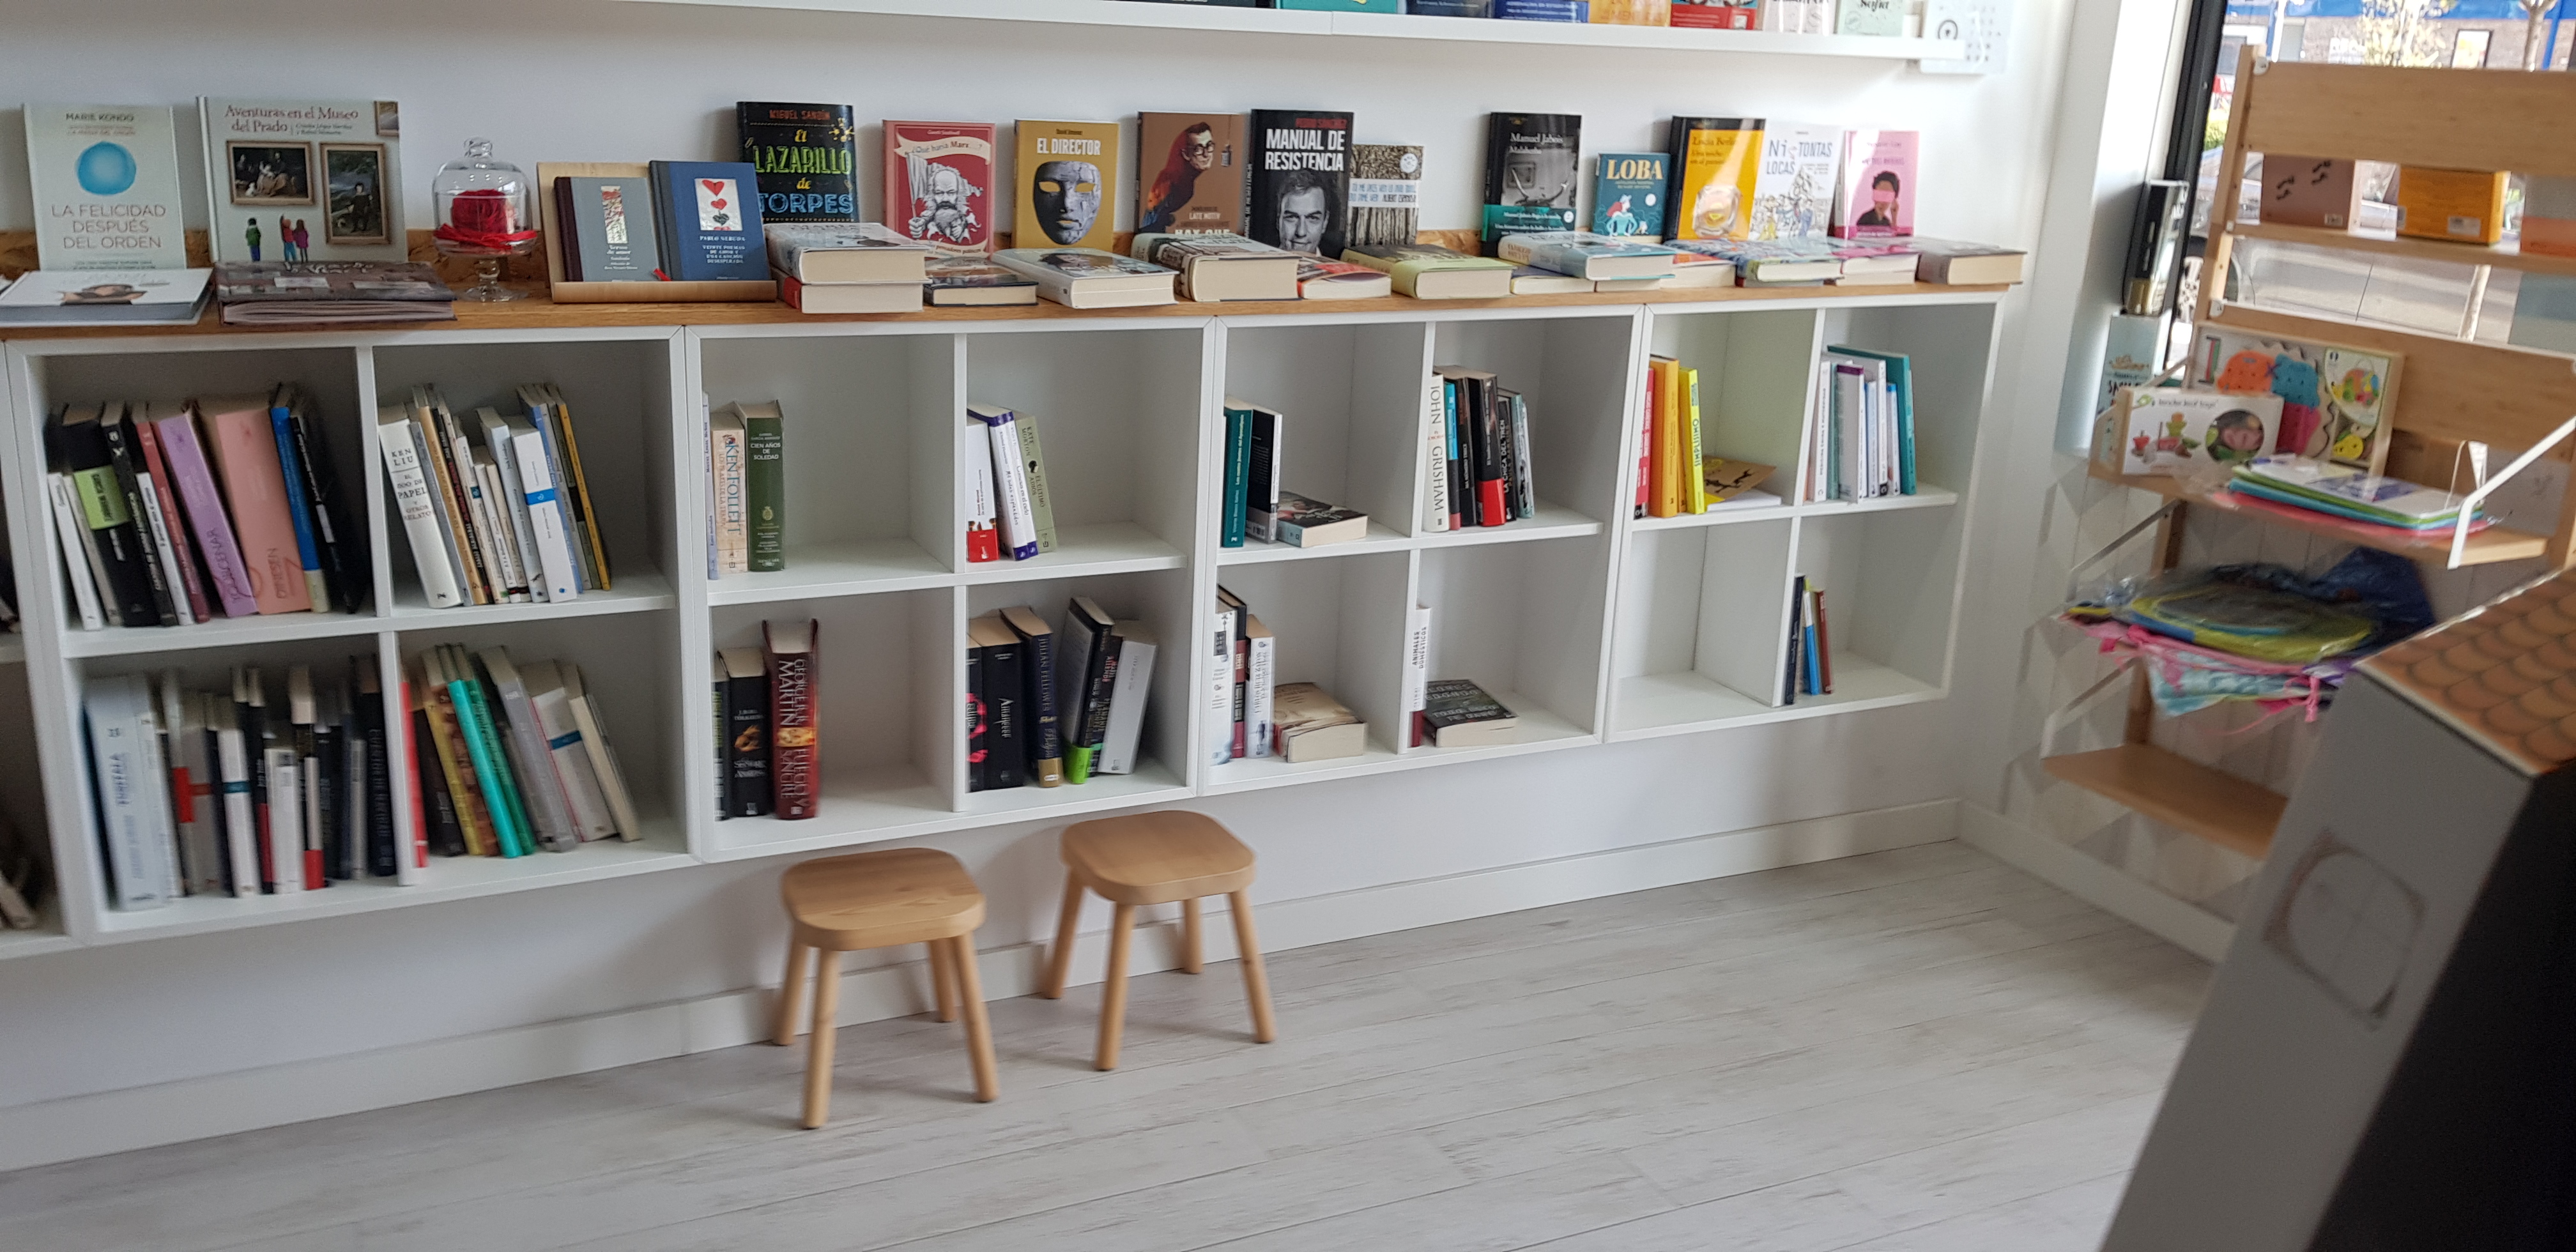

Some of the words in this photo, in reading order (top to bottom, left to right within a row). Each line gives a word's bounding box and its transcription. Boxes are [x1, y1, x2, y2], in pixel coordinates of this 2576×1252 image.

[66, 112, 96, 121] MARIE
[98, 114, 134, 122] KONDO
[224, 105, 286, 118] Aventuras
[288, 110, 302, 118] en
[304, 106, 315, 118] el
[318, 107, 358, 119] Museo
[769, 110, 798, 119] MIGUEL
[231, 119, 249, 132] del
[253, 119, 288, 132] Prado
[795, 129, 808, 142] El
[1266, 128, 1324, 150] MANUAL
[1328, 130, 1346, 150] DE
[1510, 132, 1540, 142] Manuel
[1037, 137, 1050, 154] EL
[1051, 138, 1101, 155] DIRECTOR
[1768, 140, 1788, 157] Ni
[1798, 142, 1833, 158] TONTAS
[753, 145, 852, 174] LAZARILLO
[1265, 151, 1344, 171] RESISTENCIA
[1606, 159, 1663, 179] LOBA
[1767, 161, 1795, 175] LOCAS
[797, 178, 811, 189] de
[52, 204, 74, 217] LA
[79, 204, 166, 218] FELICIDAD
[758, 193, 854, 214] TORPES
[73, 218, 149, 233] DESPUÉS
[64, 237, 96, 249] DEL
[101, 236, 162, 248] ORDEN
[1430, 385, 1441, 425] JOHN
[1022, 427, 1031, 457] MORTON
[1692, 418, 1701, 466] SIMPLÍSIMO
[391, 448, 411, 458] KEN
[394, 456, 413, 466] LIU
[725, 443, 739, 476] KEN
[1432, 446, 1445, 511] GRISHAM
[398, 487, 427, 499] PAPEL
[727, 477, 742, 533] FOLLETT
[1038, 638, 1050, 668] JULIAN
[794, 659, 809, 705] GEORGE
[779, 659, 798, 726] MARTIN
[993, 698, 1014, 738] Amanecer
[793, 748, 810, 796] FUEGO
